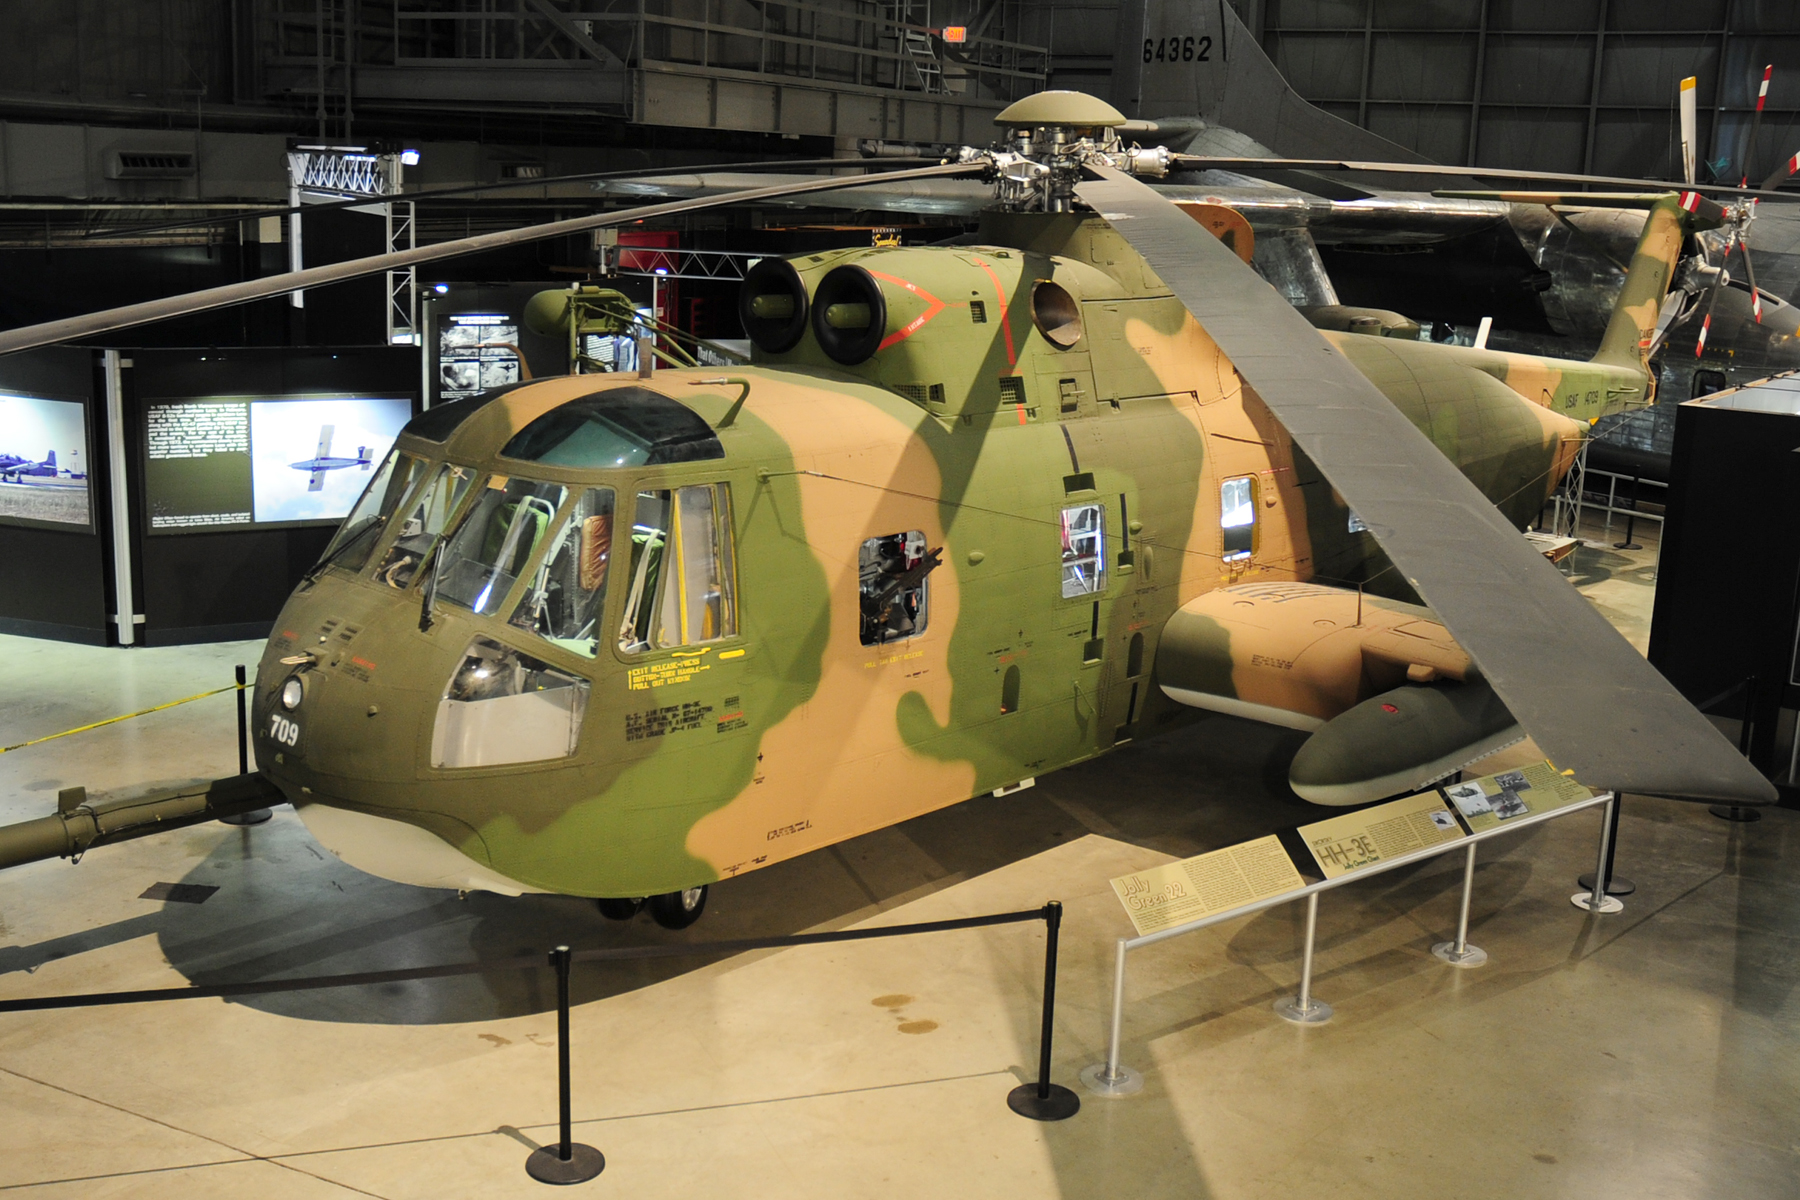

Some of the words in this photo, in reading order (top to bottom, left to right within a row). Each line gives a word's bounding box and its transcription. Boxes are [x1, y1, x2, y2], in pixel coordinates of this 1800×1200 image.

[1143, 36, 1212, 63] 64362
[632, 667, 648, 676] EXIT
[633, 682, 650, 690] PULL
[652, 678, 664, 688] OUT
[270, 714, 299, 746] 709
[1316, 835, 1376, 868] HH-3E
[1120, 876, 1150, 896] Jolly
[1127, 892, 1167, 911] Green
[1164, 881, 1187, 900] 22
